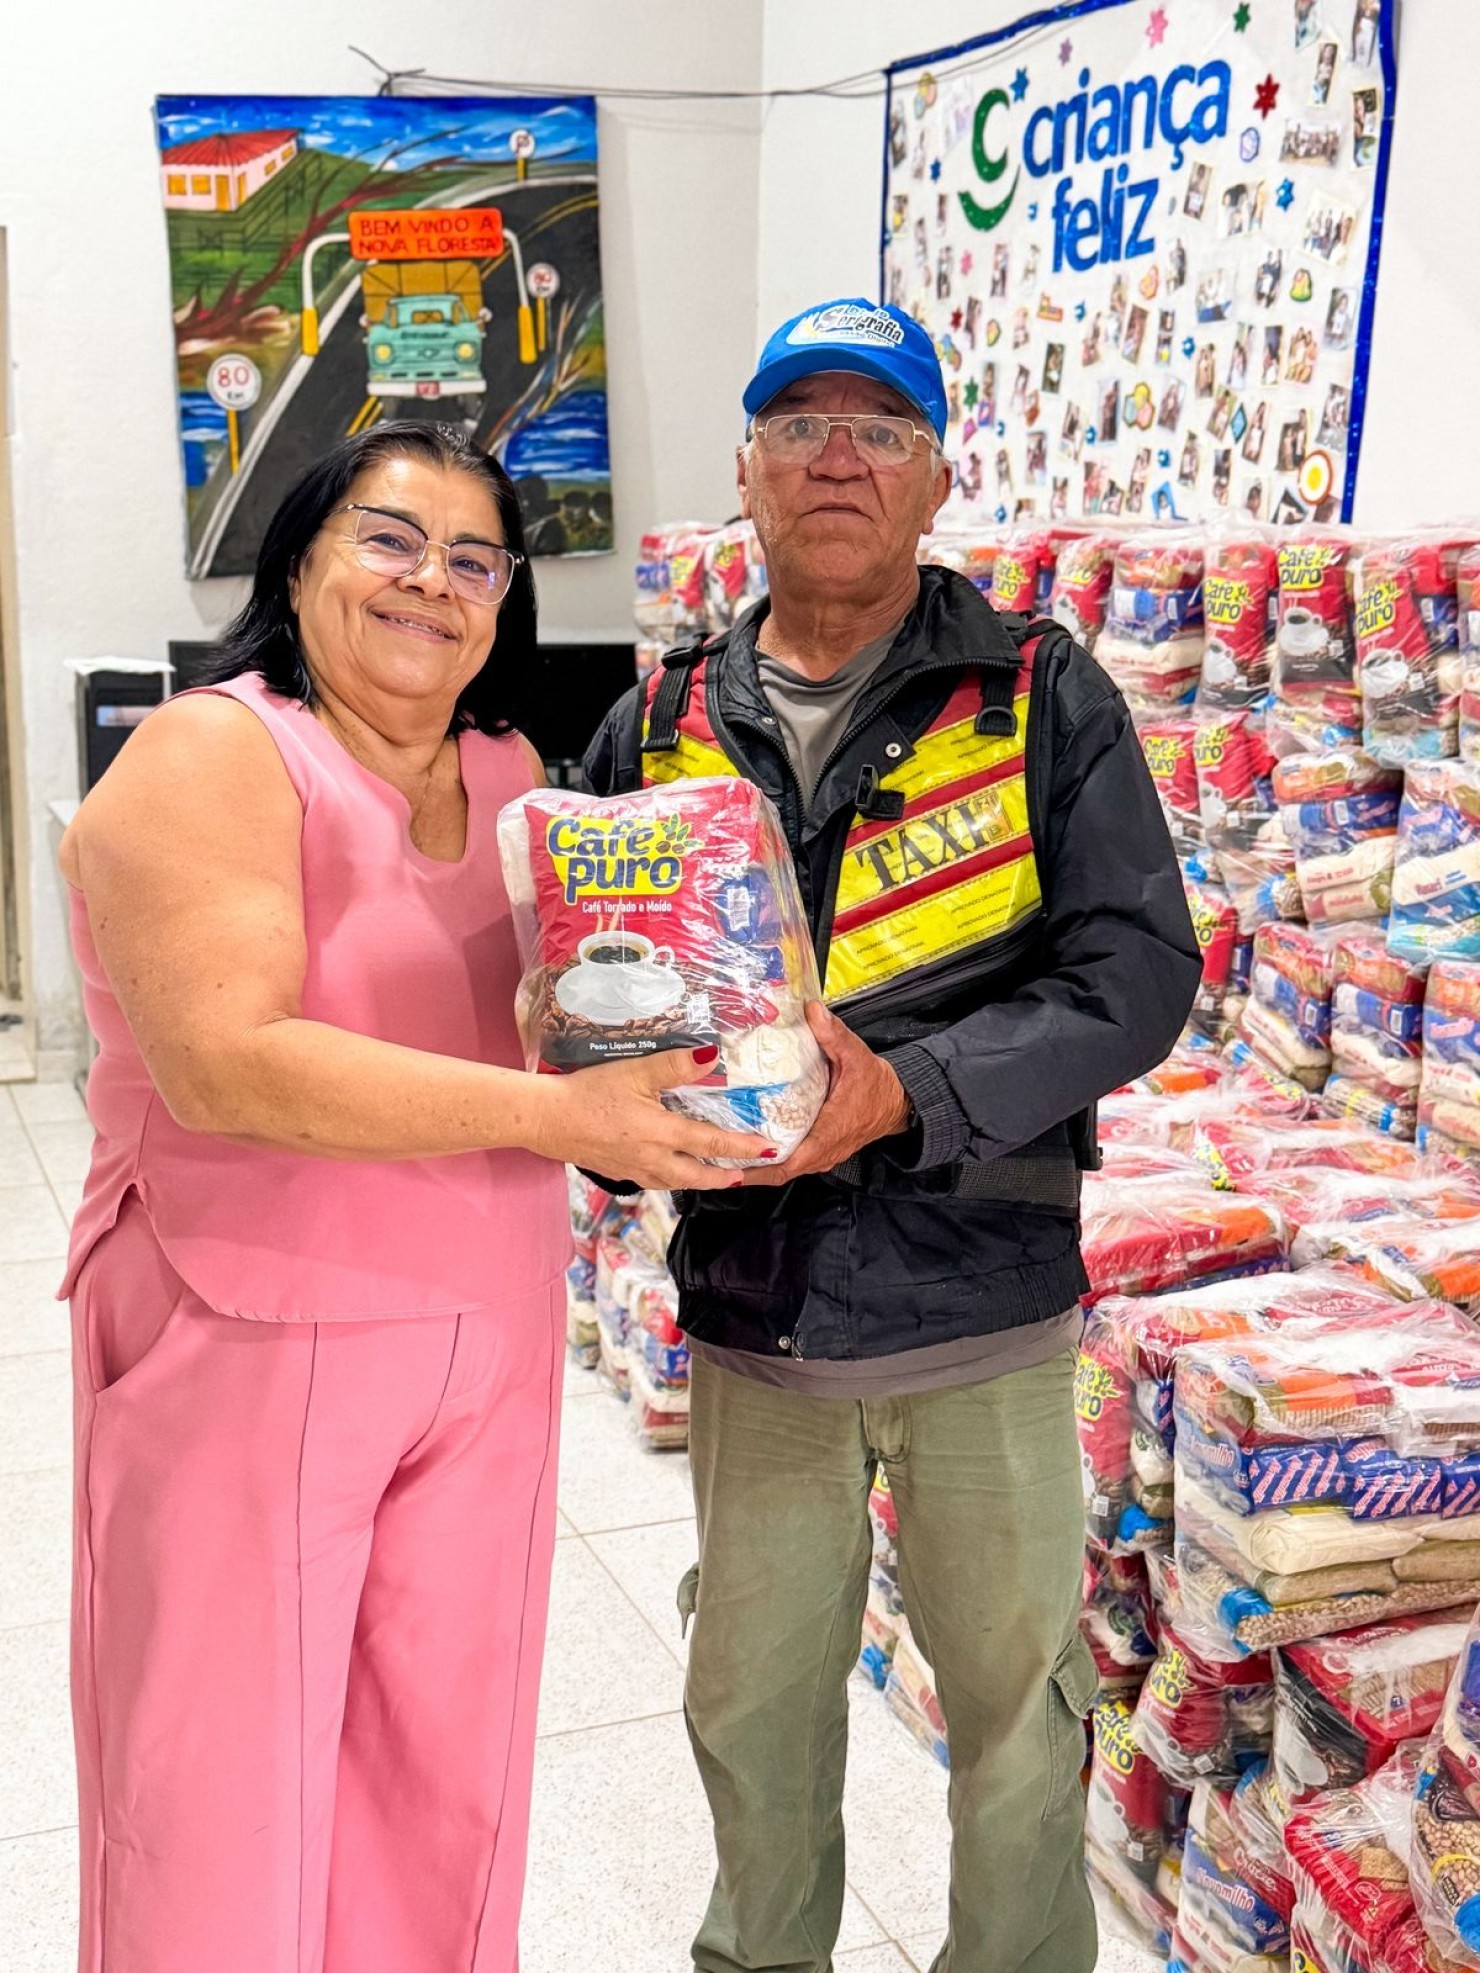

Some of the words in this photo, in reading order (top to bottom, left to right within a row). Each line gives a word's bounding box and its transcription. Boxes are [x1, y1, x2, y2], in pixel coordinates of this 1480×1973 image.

[1022, 60, 1232, 179] criança
[360, 218, 400, 236] BEM
[408, 216, 470, 234] VINDO
[480, 214, 494, 232] A
[1051, 162, 1160, 273] feliz
[358, 239, 408, 255] NOVA
[416, 237, 498, 254] FLORESTA
[818, 305, 903, 343] Serigrafia
[217, 365, 251, 388] 80
[854, 803, 990, 891] TAXI
[565, 855, 681, 904] puro
[581, 900, 602, 913] Café
[638, 902, 645, 912] e
[646, 898, 673, 913] Moído
[589, 1042, 608, 1051] Peso
